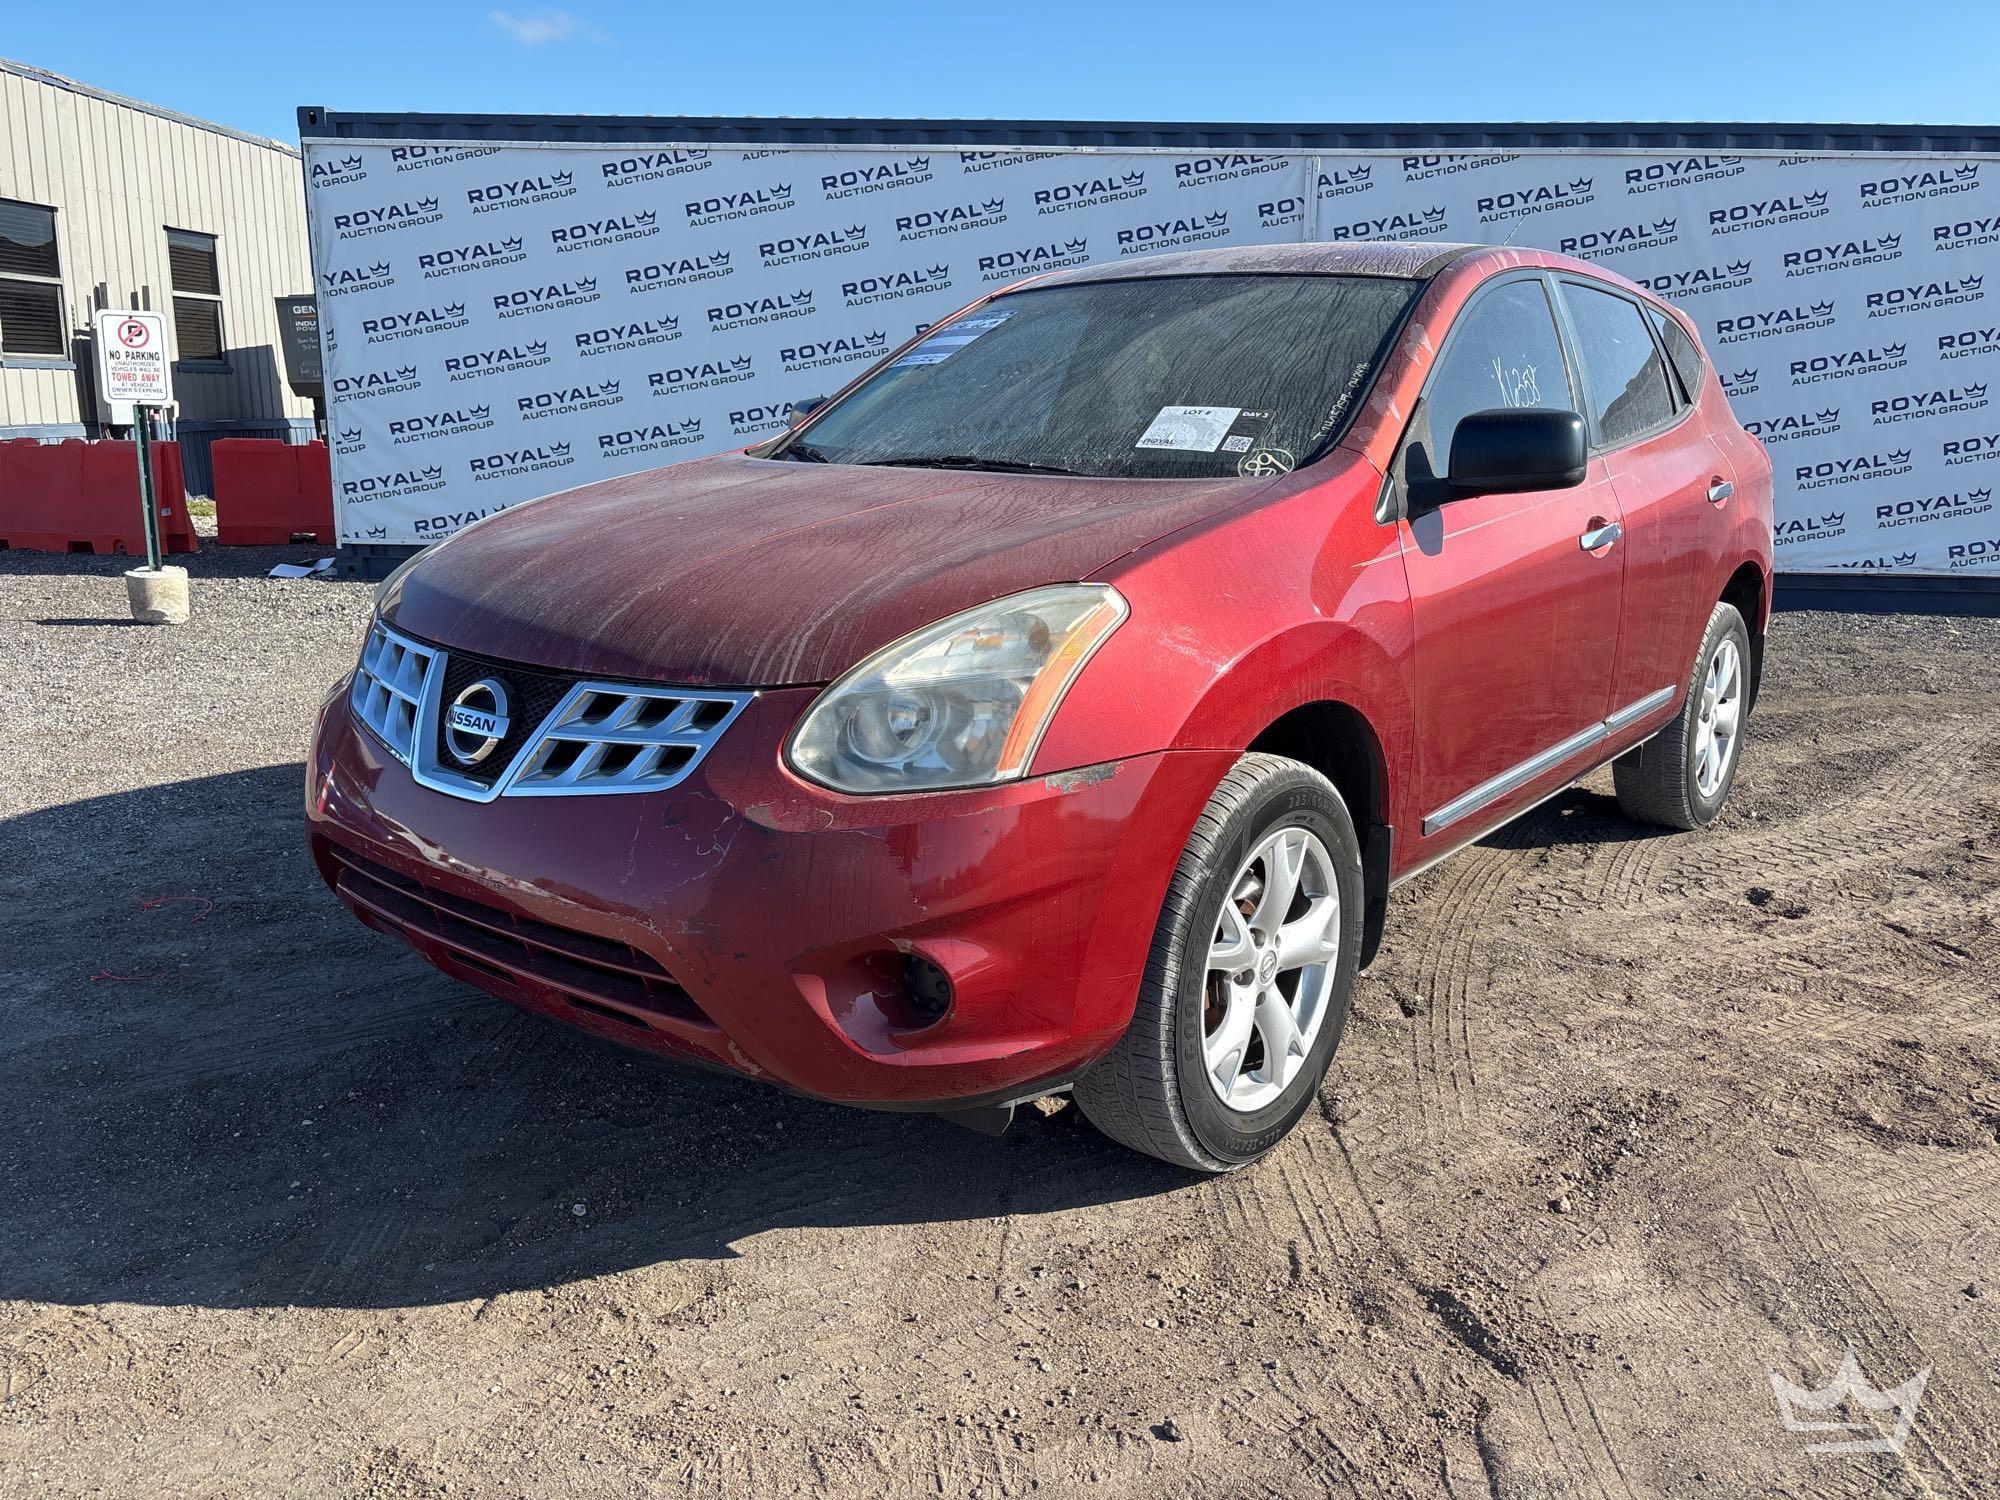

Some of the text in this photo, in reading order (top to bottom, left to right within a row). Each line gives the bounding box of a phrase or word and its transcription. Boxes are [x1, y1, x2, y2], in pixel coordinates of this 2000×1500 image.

[602, 151, 687, 177] ROYAL
[607, 161, 712, 188] AUCTION GROUP
[821, 163, 908, 190] ROYAL
[1175, 155, 1263, 178] ROYAL
[1178, 161, 1288, 188] AUCTION GROUP
[1626, 156, 1718, 184] ROYAL
[324, 171, 367, 188] GROUP
[467, 177, 552, 204] ROYAL
[826, 174, 933, 200] AUCTION GROUP
[1034, 178, 1122, 205] ROYAL
[1325, 181, 1374, 198] GROUP
[1628, 167, 1744, 195] AUCTION GROUP
[1861, 170, 1953, 198] ROYAL
[473, 188, 576, 214] AUCTION GROUP
[685, 190, 770, 217] ROYAL
[1038, 188, 1147, 216] AUCTION GROUP
[1477, 184, 1568, 213] ROYAL
[1862, 182, 1979, 209] AUCTION GROUP
[334, 203, 418, 229] ROYAL
[690, 200, 795, 227] AUCTION GROUP
[896, 205, 982, 231] ROYAL
[1480, 195, 1594, 223] AUCTION GROUP
[1709, 197, 1803, 225] ROYAL
[1712, 208, 1829, 236] AUCTION GROUP
[340, 214, 443, 240] AUCTION GROUP
[551, 217, 635, 243] ROYAL
[900, 215, 1007, 242] AUCTION GROUP
[1117, 218, 1205, 245] ROYAL
[1334, 213, 1422, 241] ROYAL
[1400, 224, 1447, 239] GROUP
[1560, 225, 1652, 253] ROYAL
[557, 227, 660, 254] AUCTION GROUP
[759, 231, 844, 257] ROYAL
[1121, 228, 1230, 255] AUCTION GROUP
[1628, 236, 1678, 251] GROUP
[1784, 240, 1876, 267] ROYAL
[419, 243, 502, 269] ROYAL
[424, 253, 526, 279] AUCTION GROUP
[764, 242, 869, 268] AUCTION GROUP
[979, 244, 1065, 271] ROYAL
[1786, 251, 1902, 278] AUCTION GROUP
[625, 257, 709, 283] ROYAL
[630, 268, 733, 294] AUCTION GROUP
[982, 255, 1089, 282] AUCTION GROUP
[351, 277, 395, 294] GROUP
[493, 283, 576, 309] ROYAL
[842, 271, 927, 297] ROYAL
[846, 281, 952, 307] AUCTION GROUP
[1702, 276, 1752, 293] GROUP
[1867, 281, 1958, 308] ROYAL
[499, 294, 600, 319] AUCTION GROUP
[707, 296, 791, 322] ROYAL
[1868, 292, 1984, 318] AUCTION GROUP
[363, 309, 445, 334] ROYAL
[368, 319, 469, 344] AUCTION GROUP
[712, 307, 815, 332] AUCTION GROUP
[1717, 307, 1809, 334] ROYAL
[1719, 318, 1835, 344] AUCTION GROUP
[575, 322, 658, 347] ROYAL
[580, 332, 682, 357] AUCTION GROUP
[109, 350, 160, 361] NO PARKING
[445, 347, 527, 372] ROYAL
[780, 337, 865, 362] ROYAL
[1790, 349, 1881, 375] ROYAL
[112, 372, 160, 382] TOWED AWAY
[450, 357, 551, 382] AUCTION GROUP
[648, 362, 731, 387] ROYAL
[785, 356, 841, 373] AUCTION
[1792, 360, 1907, 386] AUCTION GROUP
[378, 381, 422, 397] GROUP
[653, 372, 755, 397] AUCTION GROUP
[518, 386, 600, 411] ROYAL
[523, 396, 623, 421] AUCTION GROUP
[1872, 389, 1963, 415] ROYAL
[389, 411, 470, 435] ROYAL
[1873, 400, 1988, 425] AUCTION GROUP
[394, 420, 494, 445] AUCTION GROUP
[598, 424, 680, 448] ROYAL
[1143, 437, 1175, 445] ROYAL
[1791, 424, 1840, 440] GROUP
[603, 434, 704, 458] AUCTION GROUP
[470, 448, 550, 472] ROYAL
[475, 457, 574, 481] AUCTION GROUP
[1796, 455, 1887, 480] ROYAL
[343, 471, 423, 495] ROYAL
[1798, 466, 1912, 491] AUCTION GROUP
[348, 481, 446, 504] AUCTION GROUP
[1877, 494, 1967, 519] ROYAL
[1878, 505, 1992, 529] AUCTION GROUP
[1797, 528, 1846, 544] GROUP
[449, 709, 496, 732] NISSAN
